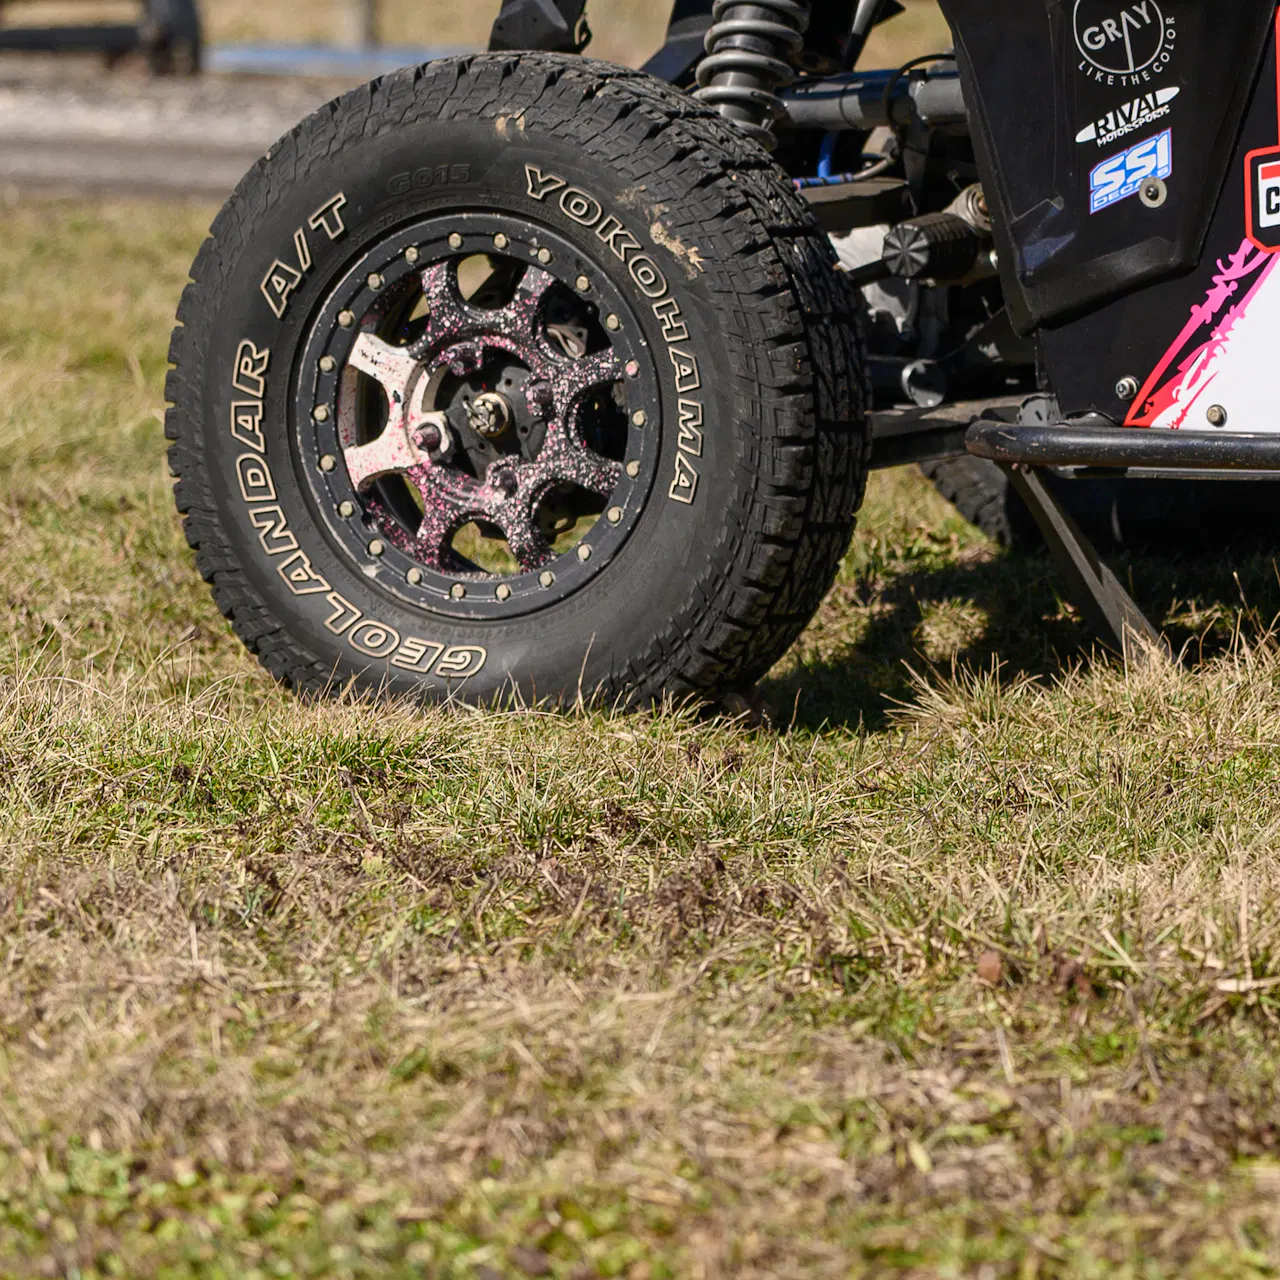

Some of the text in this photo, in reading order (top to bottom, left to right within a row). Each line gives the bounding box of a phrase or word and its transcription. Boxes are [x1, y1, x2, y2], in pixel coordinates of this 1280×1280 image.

[1078, 16, 1176, 86] LIKE THE COLOR
[1083, 0, 1151, 71] GRAY
[1090, 90, 1164, 139] RIVAL
[1097, 105, 1170, 147] MOTORSPORTS
[261, 192, 349, 317] A/T
[524, 164, 705, 504] YOKOHAMA
[231, 340, 488, 679] GEOLANDAR
